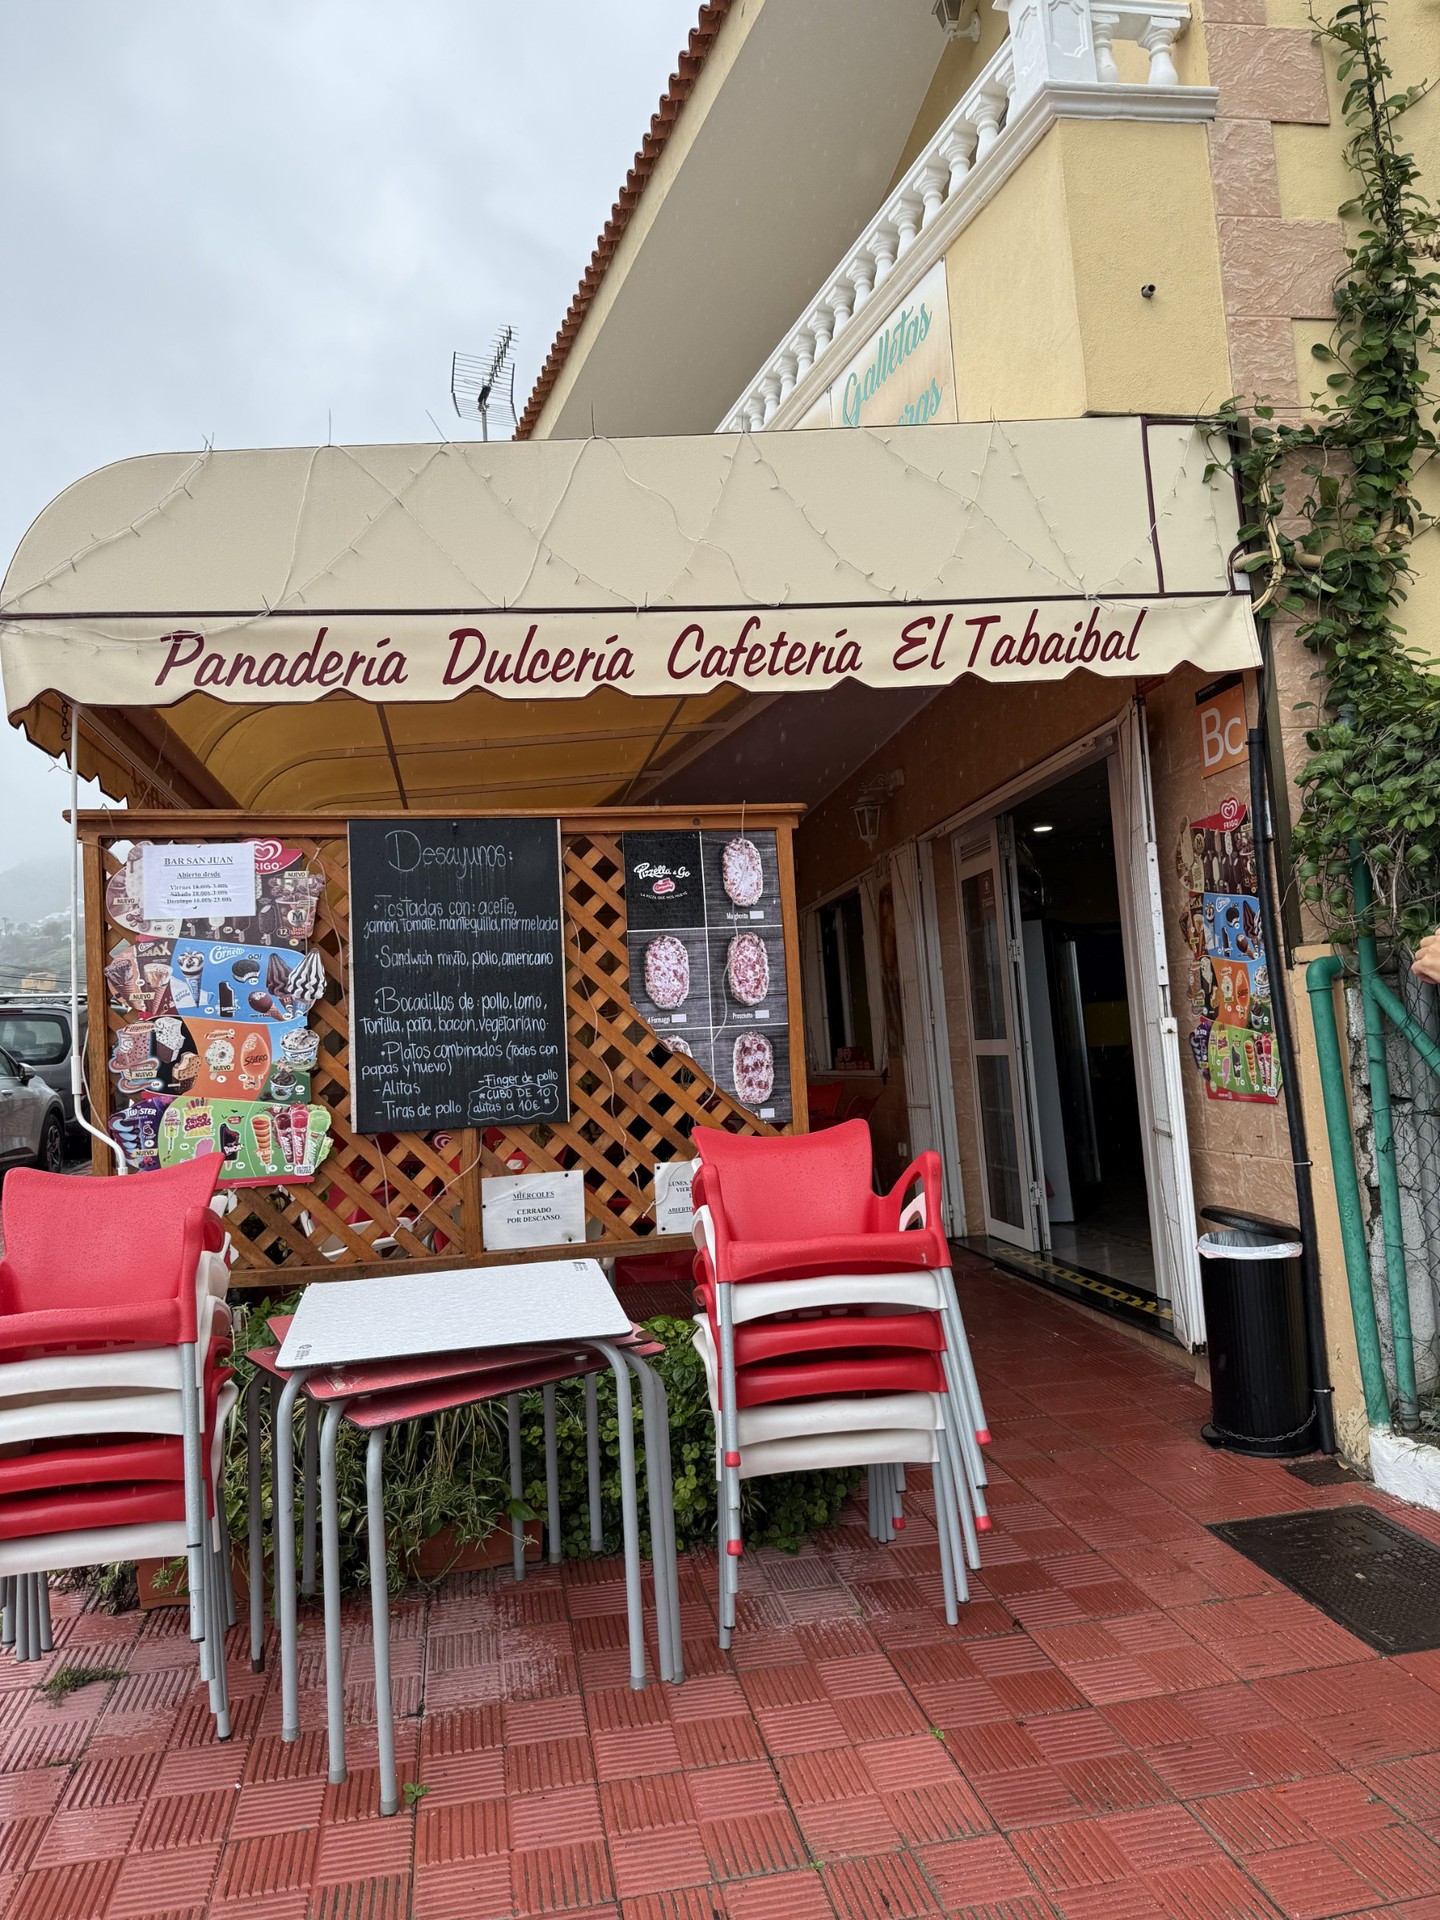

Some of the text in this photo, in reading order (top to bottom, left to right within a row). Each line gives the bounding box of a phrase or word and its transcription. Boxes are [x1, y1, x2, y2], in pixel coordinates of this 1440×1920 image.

[842, 303, 932, 426] Galletas
[155, 606, 1150, 687] Panadería Dulcería Cafetería El Tabaibal
[1201, 707, 1243, 767] Bc
[164, 857, 184, 865] BAR
[208, 856, 233, 864] JUAN
[385, 830, 513, 879] Desayunos:
[255, 862, 279, 870] RIGO
[676, 866, 690, 878] Go
[375, 895, 443, 917] Tostadas
[501, 915, 559, 932] mermelada
[380, 945, 433, 968] Sandwich
[501, 951, 554, 966] americano
[375, 987, 454, 1014] Bocadillos
[383, 1042, 431, 1061] Platos
[433, 1042, 503, 1060] combinados
[539, 1044, 558, 1056] con
[361, 1062, 399, 1080] papas
[402, 1064, 411, 1077] y
[521, 1072, 533, 1083] de
[536, 1069, 559, 1086] pollo
[517, 1089, 532, 1098] DE
[537, 1087, 550, 1097] 10
[417, 1103, 432, 1117] de
[435, 1100, 462, 1119] pollo
[473, 1101, 502, 1114] alitas
[506, 1102, 515, 1111] a
[516, 1207, 552, 1215] CERRADO
